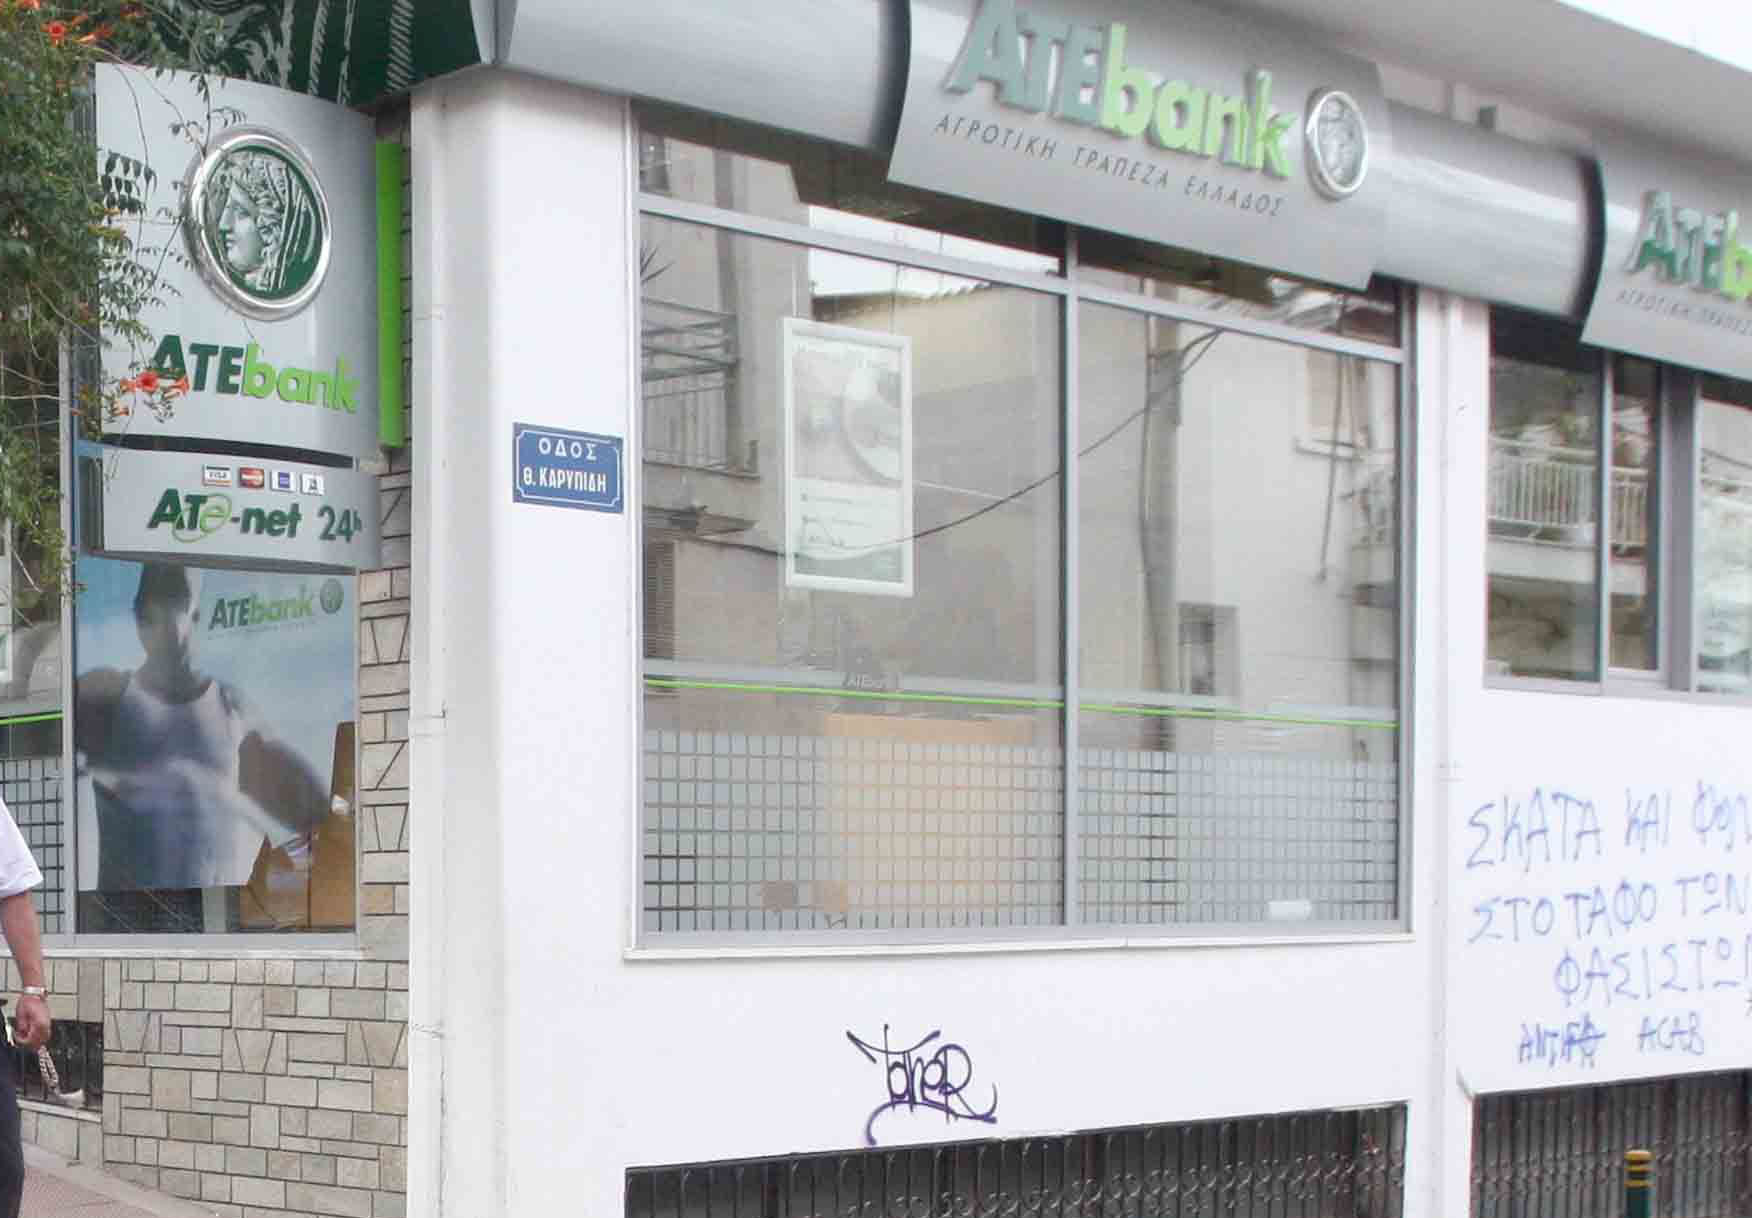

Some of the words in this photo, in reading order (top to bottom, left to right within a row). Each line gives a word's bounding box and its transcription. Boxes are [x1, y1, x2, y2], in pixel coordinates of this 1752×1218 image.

[941, 0, 1298, 182] ATEbank
[935, 114, 1057, 158] ΑΓΡΟΤΙΚΗ
[1071, 146, 1169, 189] ΤΡΑΠΕΖΑ
[1184, 175, 1286, 217] ΕΛΛΑΔΟΣ
[539, 437, 597, 461] ΟΔΟΣ
[539, 467, 607, 493] ΚΑΡΥΠΙΔΗ
[1466, 787, 1603, 873] ΣΚΑΤΑ
